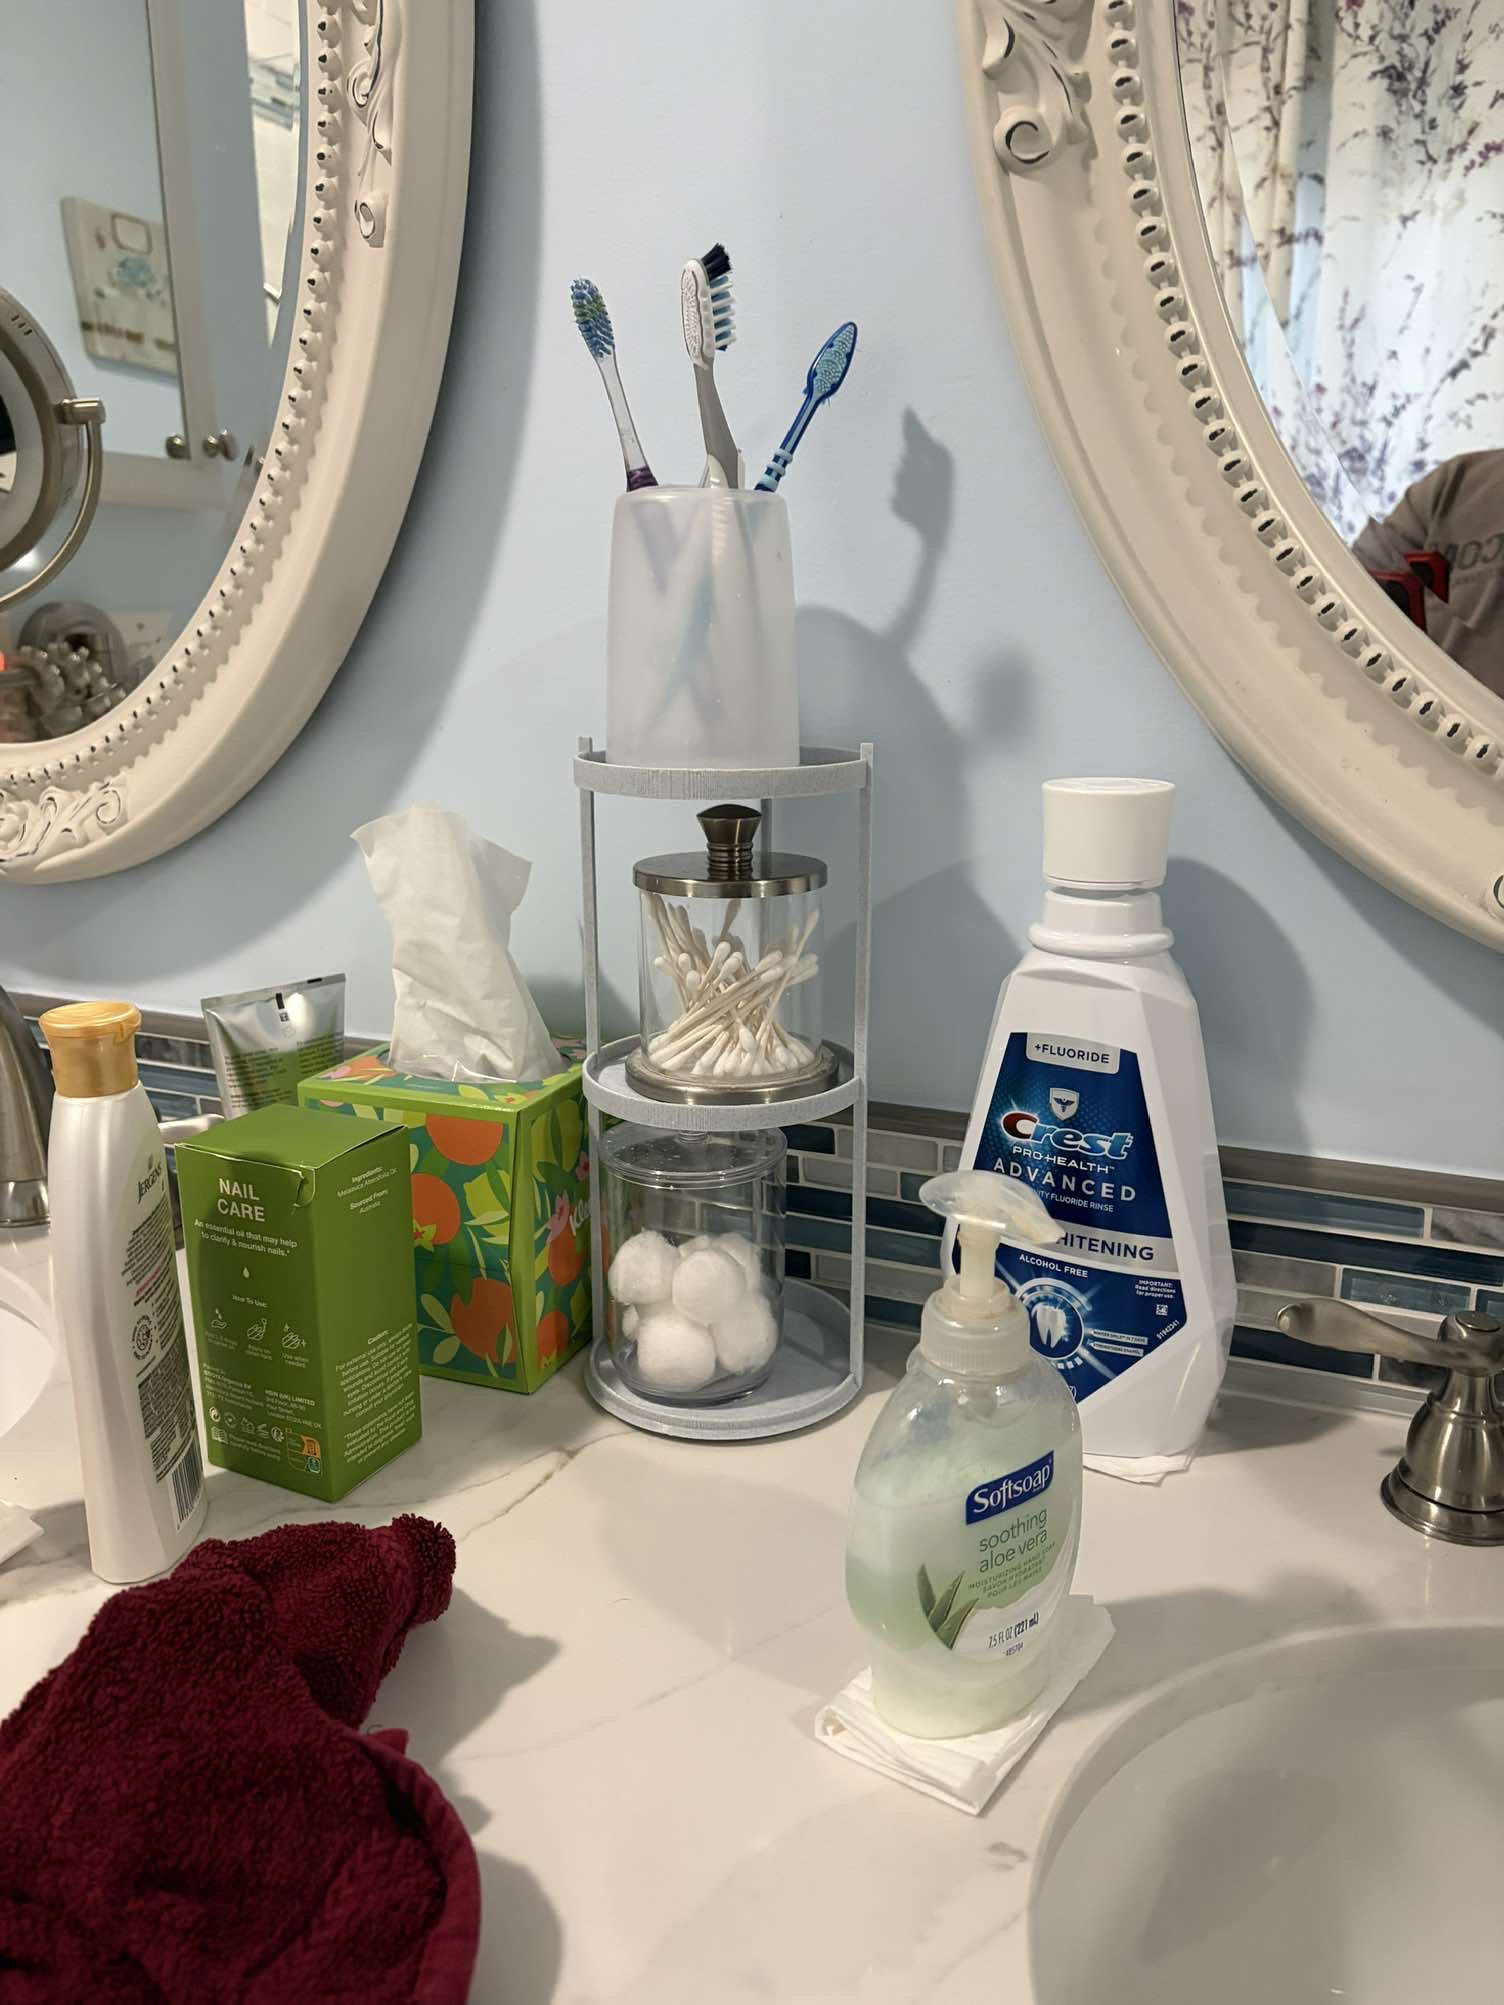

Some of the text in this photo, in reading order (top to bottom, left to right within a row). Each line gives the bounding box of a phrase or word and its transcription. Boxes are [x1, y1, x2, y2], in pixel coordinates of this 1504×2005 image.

[1035, 1043, 1110, 1064] +FLUORIDE
[1001, 1110, 1134, 1160] Crest
[219, 1178, 259, 1200] NAIL
[993, 1157, 1136, 1201] ADVANCED
[217, 1198, 265, 1222] CARE
[1050, 1193, 1089, 1208] FLUORIDE
[1090, 1200, 1114, 1213] RINSE
[201, 1231, 209, 1239] to
[239, 1241, 266, 1253] nourish
[205, 1222, 234, 1235] essential
[236, 1229, 245, 1237] oil
[246, 1231, 261, 1241] that
[263, 1236, 278, 1246] may
[280, 1237, 297, 1248] help
[1056, 1231, 1154, 1261] HITENING
[1019, 1254, 1089, 1278] ALCOHOL FREE
[973, 1464, 1050, 1513] Softsoap
[979, 1508, 1047, 1552] soothing
[979, 1529, 1047, 1573] aloe vera
